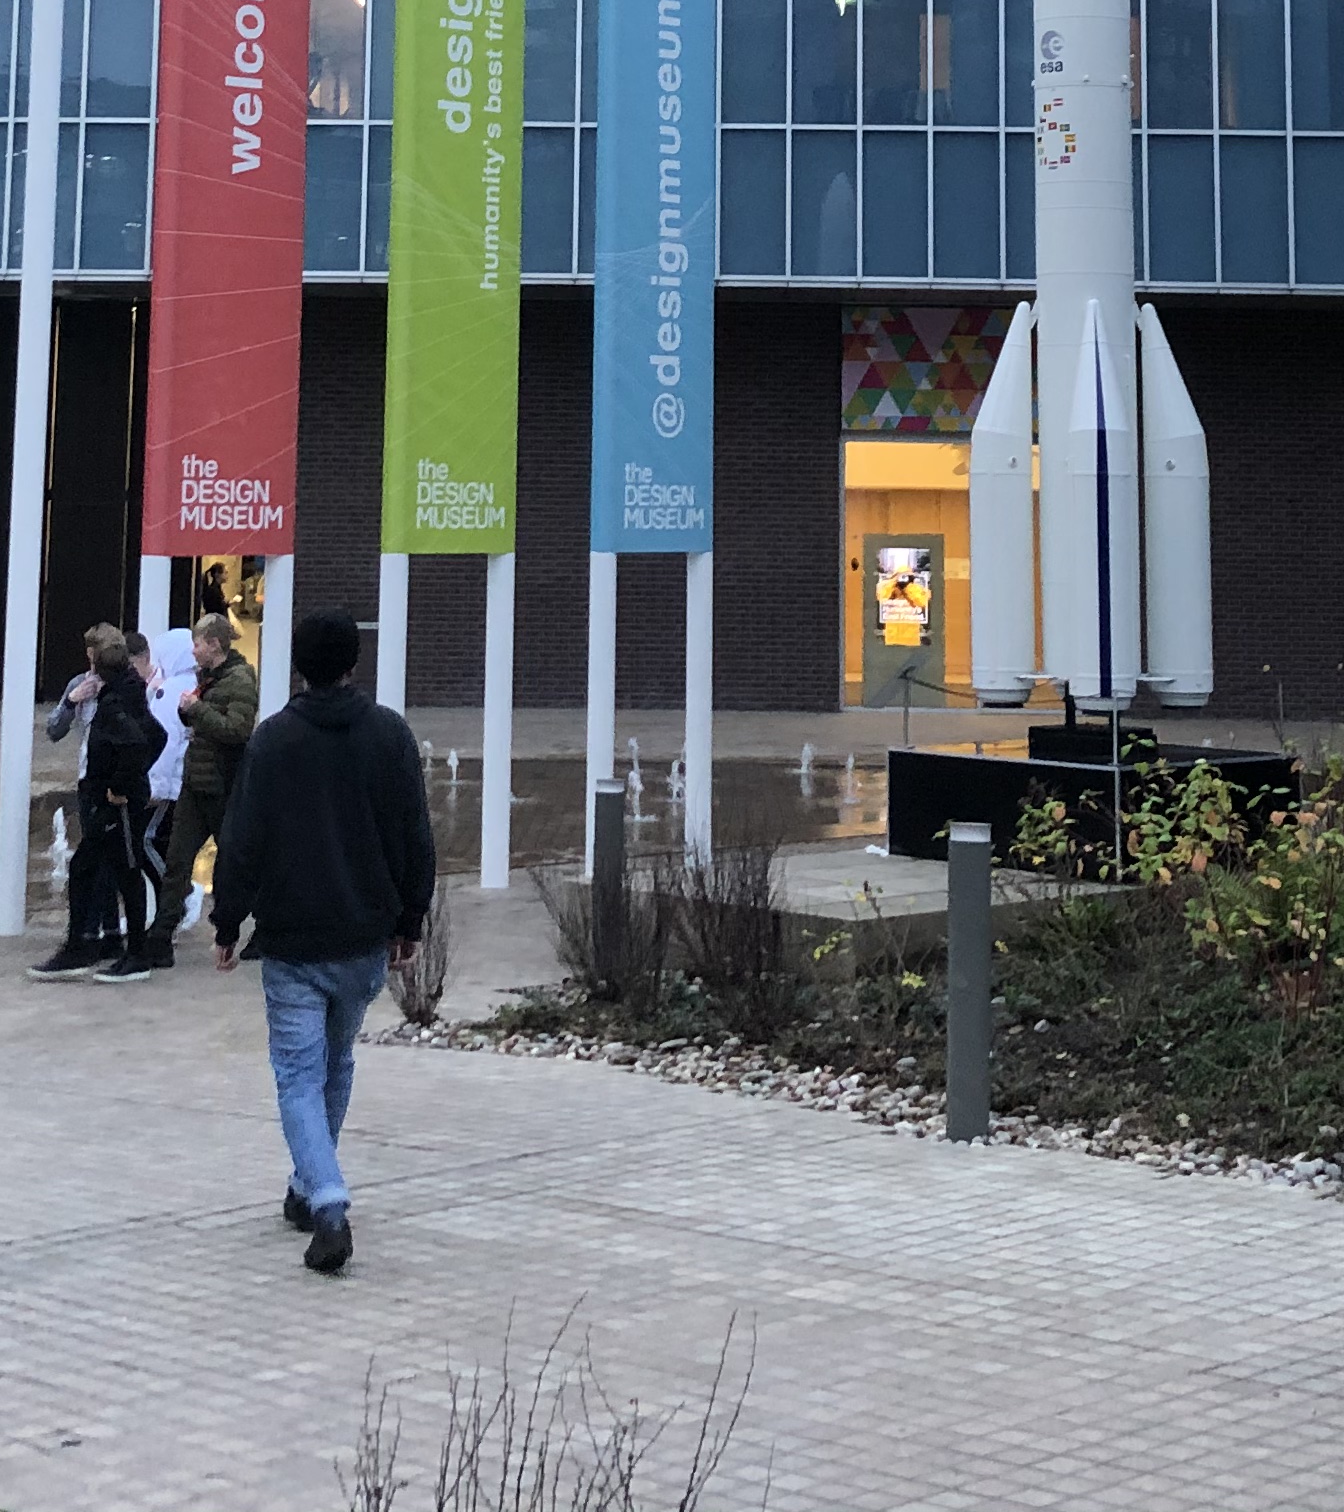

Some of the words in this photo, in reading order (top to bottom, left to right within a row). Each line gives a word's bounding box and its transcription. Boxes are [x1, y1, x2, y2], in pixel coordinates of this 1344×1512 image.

[1040, 60, 1064, 74] esa
[483, 49, 503, 113] best
[480, 122, 505, 290] humanity's
[182, 454, 218, 478] the
[418, 457, 448, 480] the
[624, 462, 653, 483] the
[181, 479, 270, 504] DESIGN
[417, 481, 494, 505] DESIGN
[624, 484, 695, 506] DESIGN
[180, 505, 283, 530] MUSEUM
[416, 506, 505, 530] MUSEUM
[624, 507, 704, 529] MUSEUM
